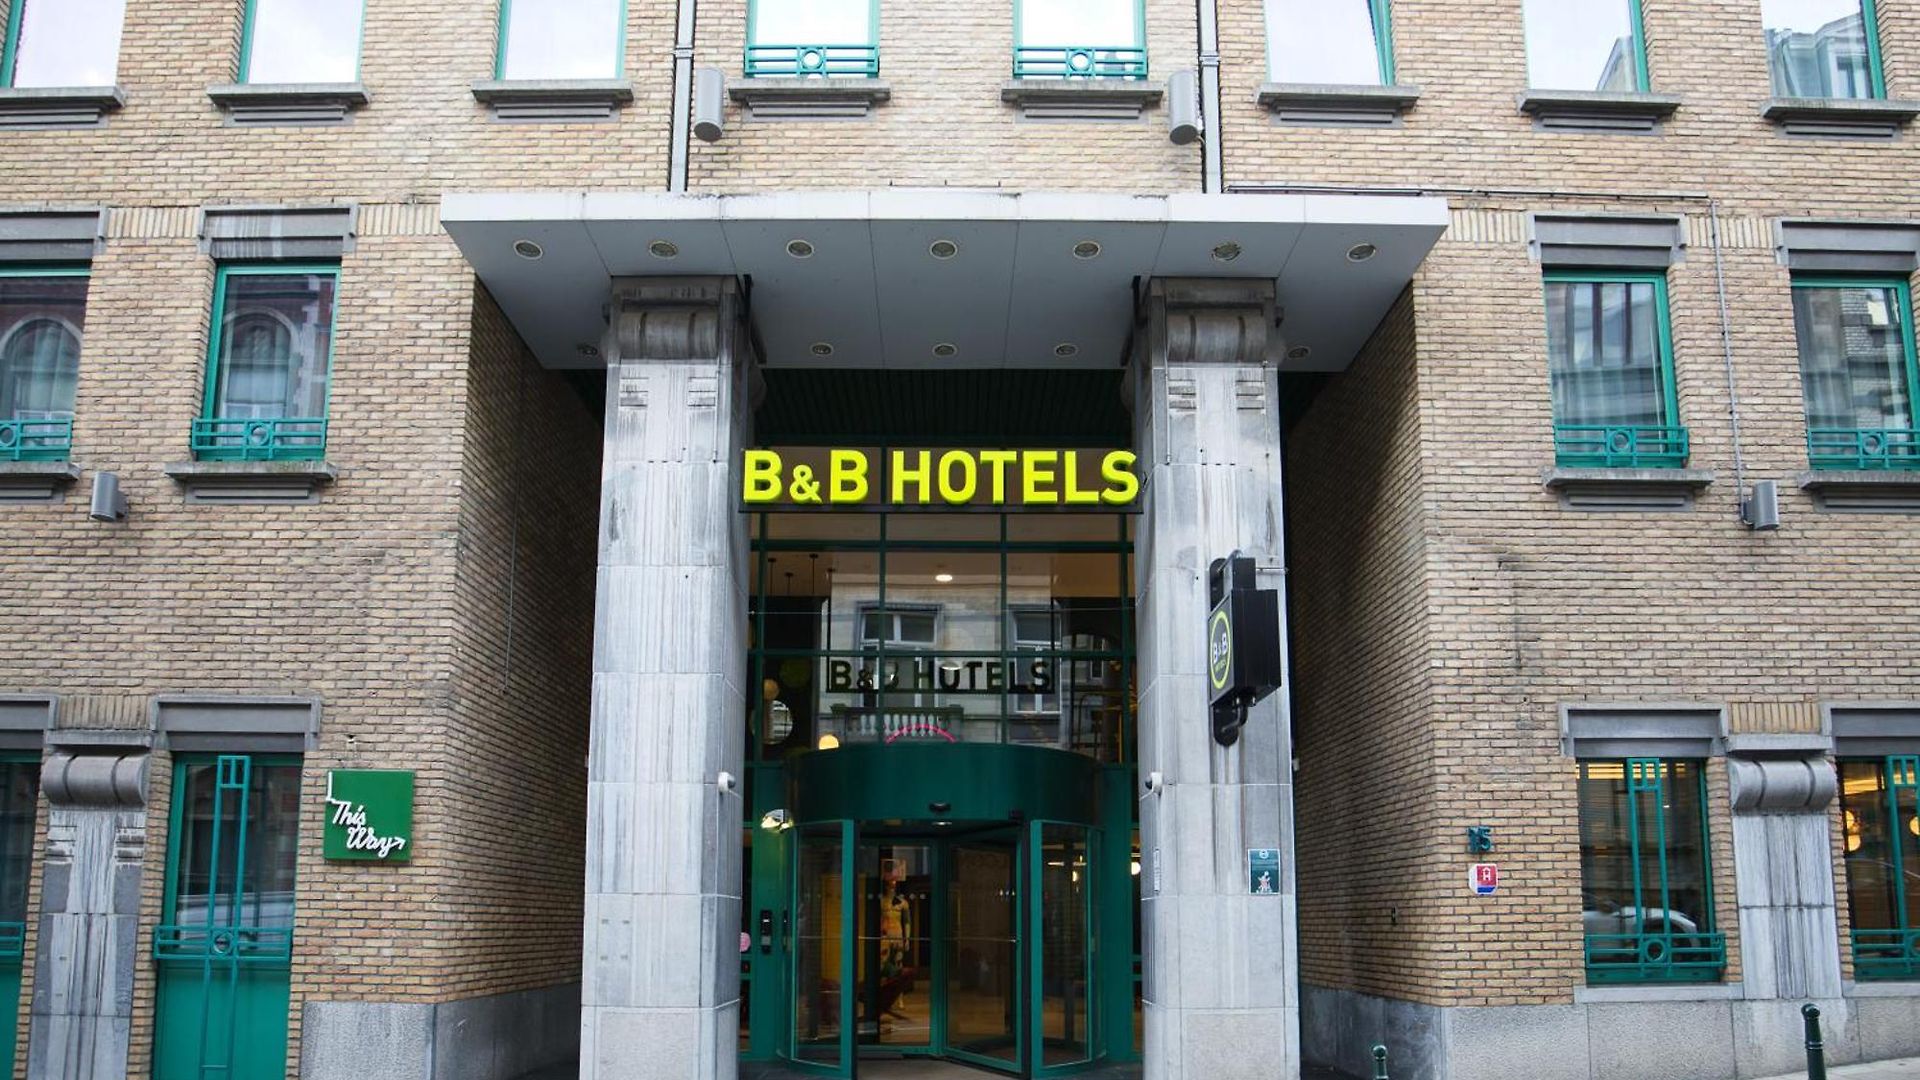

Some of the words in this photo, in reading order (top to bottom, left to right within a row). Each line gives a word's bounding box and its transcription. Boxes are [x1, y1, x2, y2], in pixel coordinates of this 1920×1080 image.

[743, 449, 869, 504] B&B
[891, 449, 1140, 504] HOTELS
[914, 661, 1050, 691] HOTELS
[332, 800, 366, 825] This
[346, 826, 391, 857] Way
